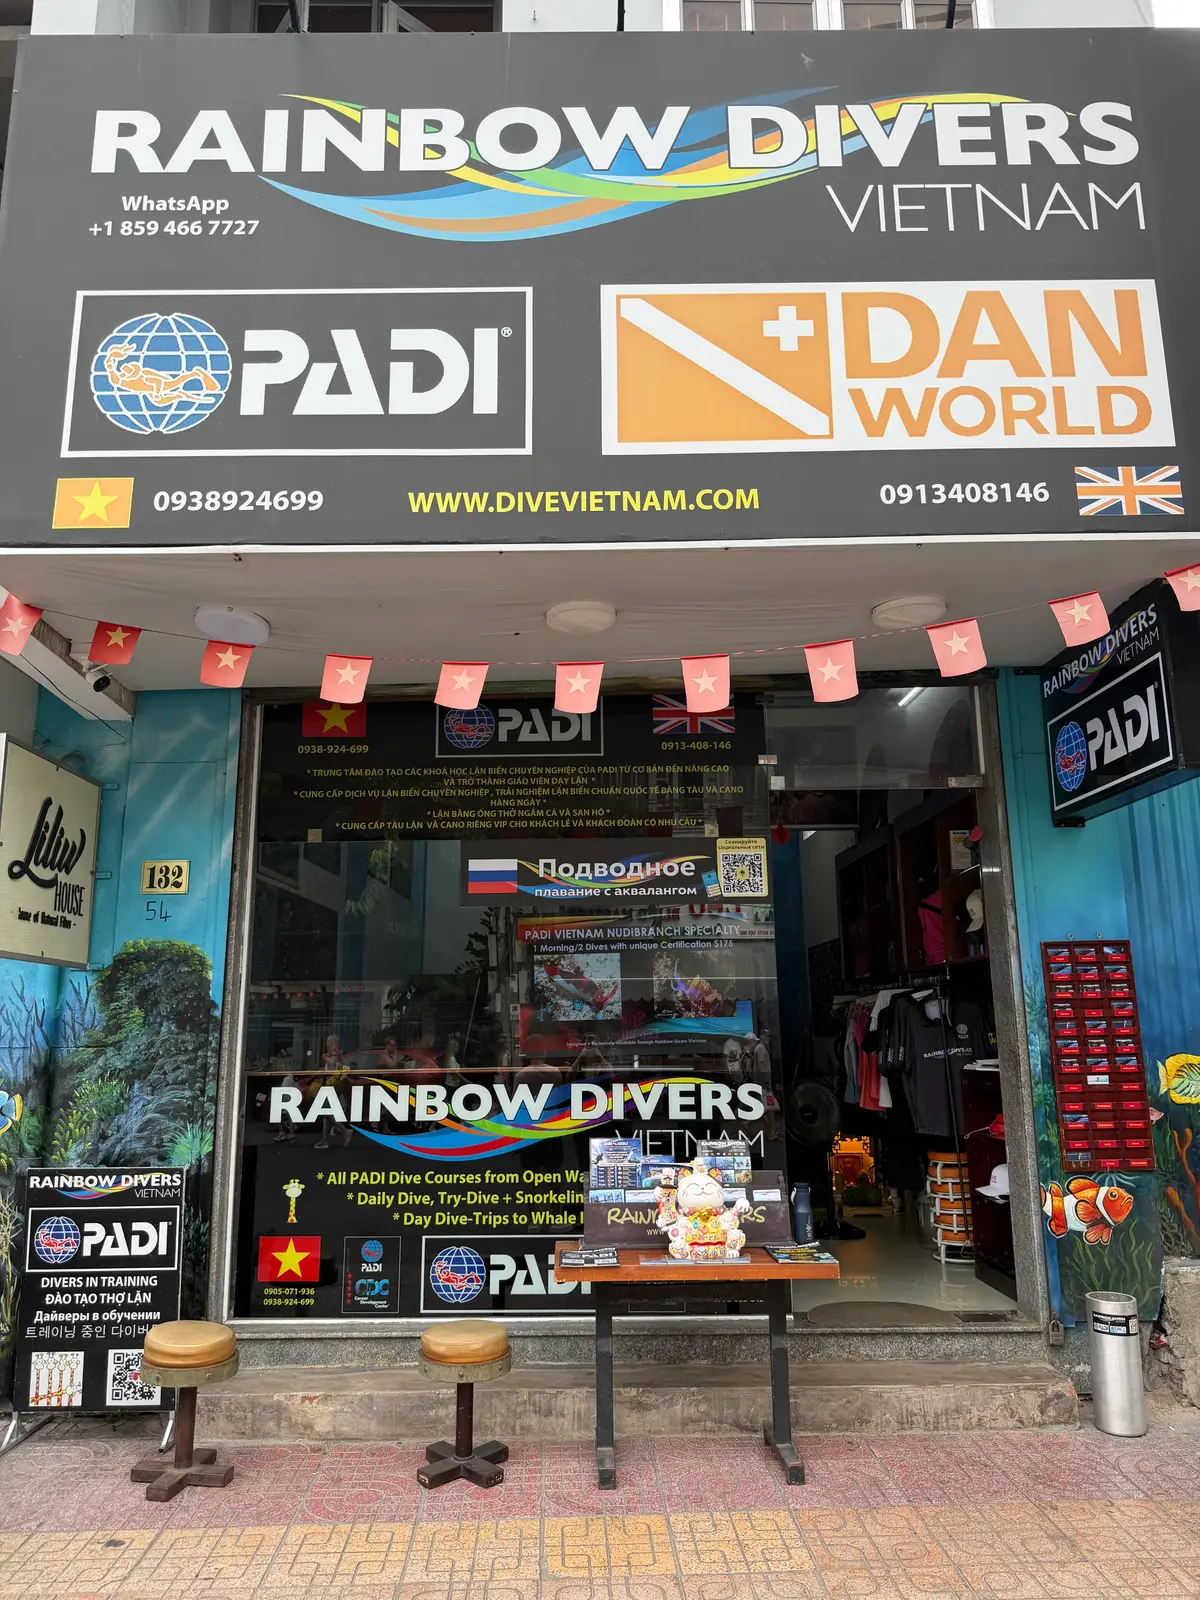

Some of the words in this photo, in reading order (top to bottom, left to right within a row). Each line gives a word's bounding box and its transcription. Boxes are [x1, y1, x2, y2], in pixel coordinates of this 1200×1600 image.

[90, 105, 691, 174] RAINBOW
[727, 101, 1140, 169] DIVERS
[121, 195, 230, 214] WhatsApp
[825, 182, 1146, 232] VIETNAM
[88, 220, 113, 236] +1
[119, 220, 159, 236] 859
[163, 220, 203, 236] 466
[207, 219, 260, 236] 7727
[841, 289, 1148, 379] DAN
[847, 385, 1153, 438] WORLD
[153, 489, 324, 512] 0938924699
[408, 488, 760, 514] WWW.DIVEVIETNAM.COM
[879, 482, 1050, 505] 0913408146
[1043, 641, 1103, 698] RAINBOW
[1105, 603, 1157, 653] DIVERS
[1116, 626, 1160, 664] VIETNAM
[498, 708, 591, 742] PADI
[297, 744, 369, 754] 0938-924-699
[661, 740, 732, 750] 0913-408-146
[344, 768, 362, 776] TÂM
[364, 768, 383, 776] ĐÀO
[385, 768, 402, 778] TẠO
[404, 767, 422, 776] CÁC
[424, 767, 447, 776] KHOÁ
[449, 767, 468, 778] HỌC
[509, 766, 542, 775] CHUYÊN
[545, 766, 576, 776] NGHIỆP
[597, 766, 618, 774] PADI
[711, 765, 729, 773] CAO
[443, 778, 455, 786] VÀ
[476, 777, 505, 786] THÀNH
[507, 777, 529, 785] GIÁO
[300, 790, 324, 798] CUNG
[326, 788, 343, 798] CẤP
[345, 790, 366, 799] DỊCH
[368, 790, 379, 799] VỤ
[422, 788, 456, 797] CHUYÊN
[687, 785, 704, 793] TÀU
[705, 785, 718, 793] VÀ
[719, 785, 744, 793] CANO
[490, 798, 515, 807] HÀNG
[517, 798, 541, 807] NGÀY
[545, 808, 558, 817] CÁ
[559, 808, 571, 817] VÀ
[572, 809, 590, 817] SAN
[341, 822, 366, 830] CUNG
[368, 820, 385, 829] CẤP
[386, 821, 404, 829] TÀU
[426, 820, 439, 829] VÀ
[440, 821, 465, 829] CANO
[466, 820, 492, 828] RIÊNG
[494, 820, 507, 828] VIP
[509, 820, 528, 828] CHO
[529, 819, 559, 828] KHÁCH
[572, 819, 584, 827] VÀ
[586, 818, 615, 827] KHÁCH
[617, 818, 643, 827] ĐOÀN
[644, 818, 657, 826] CÓ
[658, 818, 677, 826] NHU
[145, 865, 184, 889] 132
[538, 858, 696, 880] Подводное
[54, 881, 86, 917] HOUSE
[534, 886, 601, 898] плавание
[603, 887, 612, 896] с
[614, 885, 697, 897] аквалангом
[145, 900, 172, 922] 54
[525, 930, 551, 940] PADI
[554, 928, 604, 939] VIETNAM
[607, 926, 681, 938] NUDIBRANCH
[684, 924, 740, 936] SPECIALTY
[540, 943, 584, 954] Morning/2
[586, 942, 608, 951] Dives
[610, 941, 627, 950] with
[629, 942, 659, 952] unique
[660, 939, 712, 949] Certification
[713, 939, 734, 948] $175
[269, 1082, 554, 1124] RAINBOW
[570, 1083, 765, 1121] DIVERS
[30, 1174, 116, 1189] RAINBOW
[121, 1173, 182, 1188] DIVERS
[327, 1171, 347, 1185] All
[350, 1171, 385, 1185] PADI
[389, 1171, 421, 1185] Dive
[424, 1170, 482, 1184] Courses
[484, 1170, 523, 1183] from
[526, 1170, 562, 1187] Open
[134, 1188, 181, 1199] VIETNAM
[357, 1192, 394, 1208] Daily
[397, 1192, 435, 1207] Dive,
[437, 1192, 500, 1208] Try-Dive
[515, 1190, 584, 1204] Snorkelin
[403, 1212, 431, 1229] Day
[435, 1211, 509, 1228] Dive-Trips
[512, 1213, 527, 1225] to
[529, 1211, 577, 1225] Whale
[361, 1263, 383, 1272] PADI
[41, 1276, 84, 1289] DIVERS
[86, 1276, 98, 1288] IN
[100, 1275, 158, 1288] TRAINING
[45, 1290, 72, 1304] ĐÀO
[73, 1292, 98, 1307] TẠO
[99, 1291, 126, 1306] THỢ
[127, 1291, 152, 1306] LẶN
[263, 1287, 315, 1296] 0905-071-936
[263, 1298, 315, 1307] 0938-924-699
[33, 1310, 90, 1325] Дайверы
[92, 1312, 99, 1321] в
[101, 1312, 161, 1324] обучении
[24, 1324, 76, 1339] 트레이닝
[81, 1324, 106, 1338] 중인
[111, 1323, 154, 1339] 다이버
